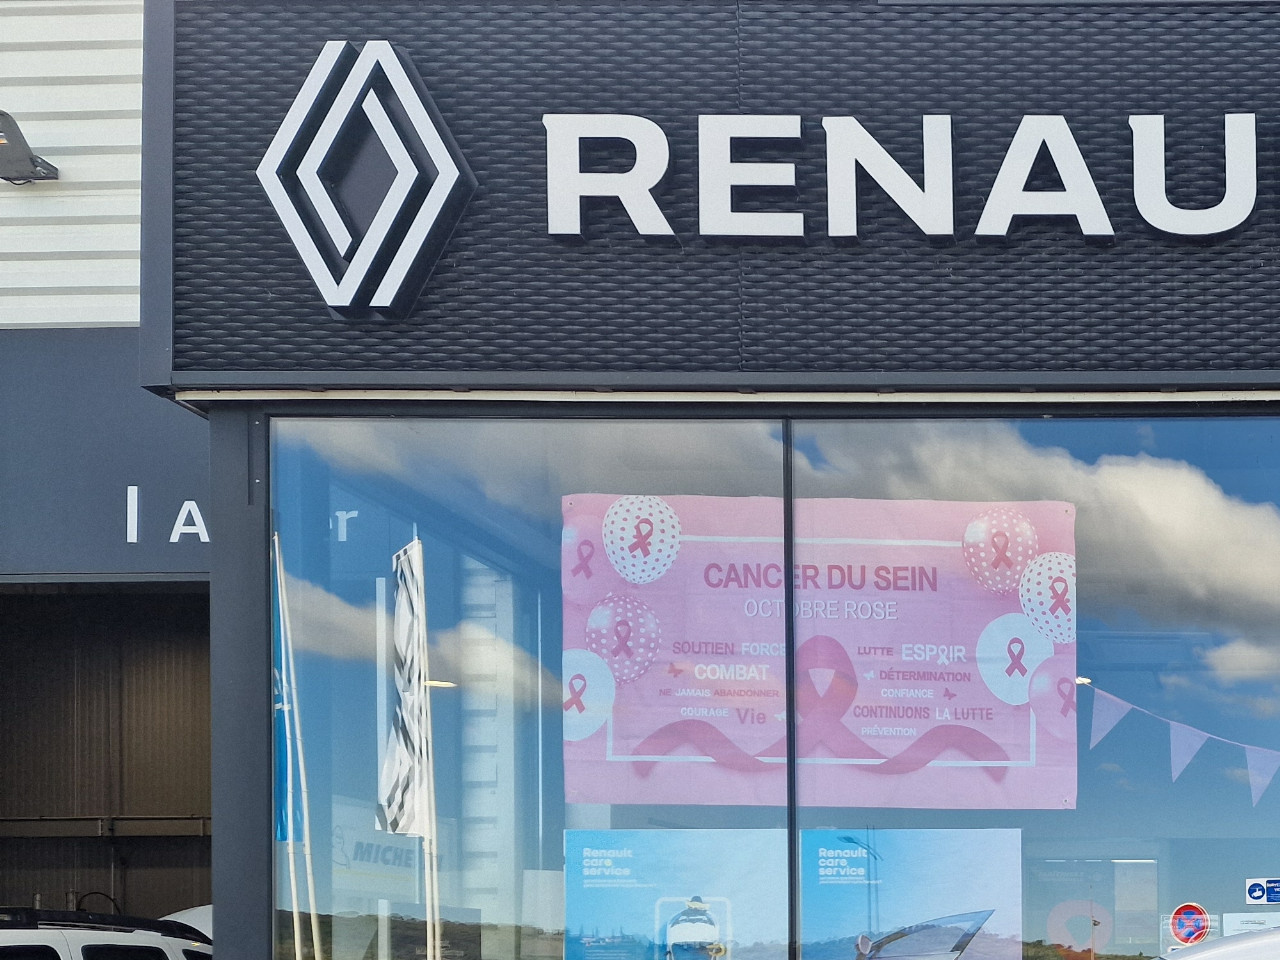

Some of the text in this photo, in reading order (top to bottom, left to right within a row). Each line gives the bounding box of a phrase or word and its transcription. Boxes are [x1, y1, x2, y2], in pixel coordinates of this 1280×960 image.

[828, 564, 866, 590] DU
[873, 565, 937, 592] SEIN
[744, 600, 898, 620] OCTBRE ROSE
[673, 641, 734, 655] SOUTIEN
[858, 646, 893, 657] LUTTE
[694, 664, 769, 680] COMBAT
[880, 668, 971, 682] DÉTERMINATION
[659, 689, 779, 698] NE JAMAIS ABANDONNER
[881, 689, 934, 698] CONFIANCE
[681, 707, 766, 725] COURAGE Vie
[853, 705, 993, 720] CONTINUONS LA LUTTE
[862, 725, 916, 736] PRÉVENTION
[352, 841, 416, 868] MICHE
[583, 847, 633, 857] Renault
[818, 847, 868, 858] Renault
[583, 859, 612, 867] care
[818, 858, 848, 867] care
[583, 867, 631, 876] service
[818, 866, 865, 876] service
